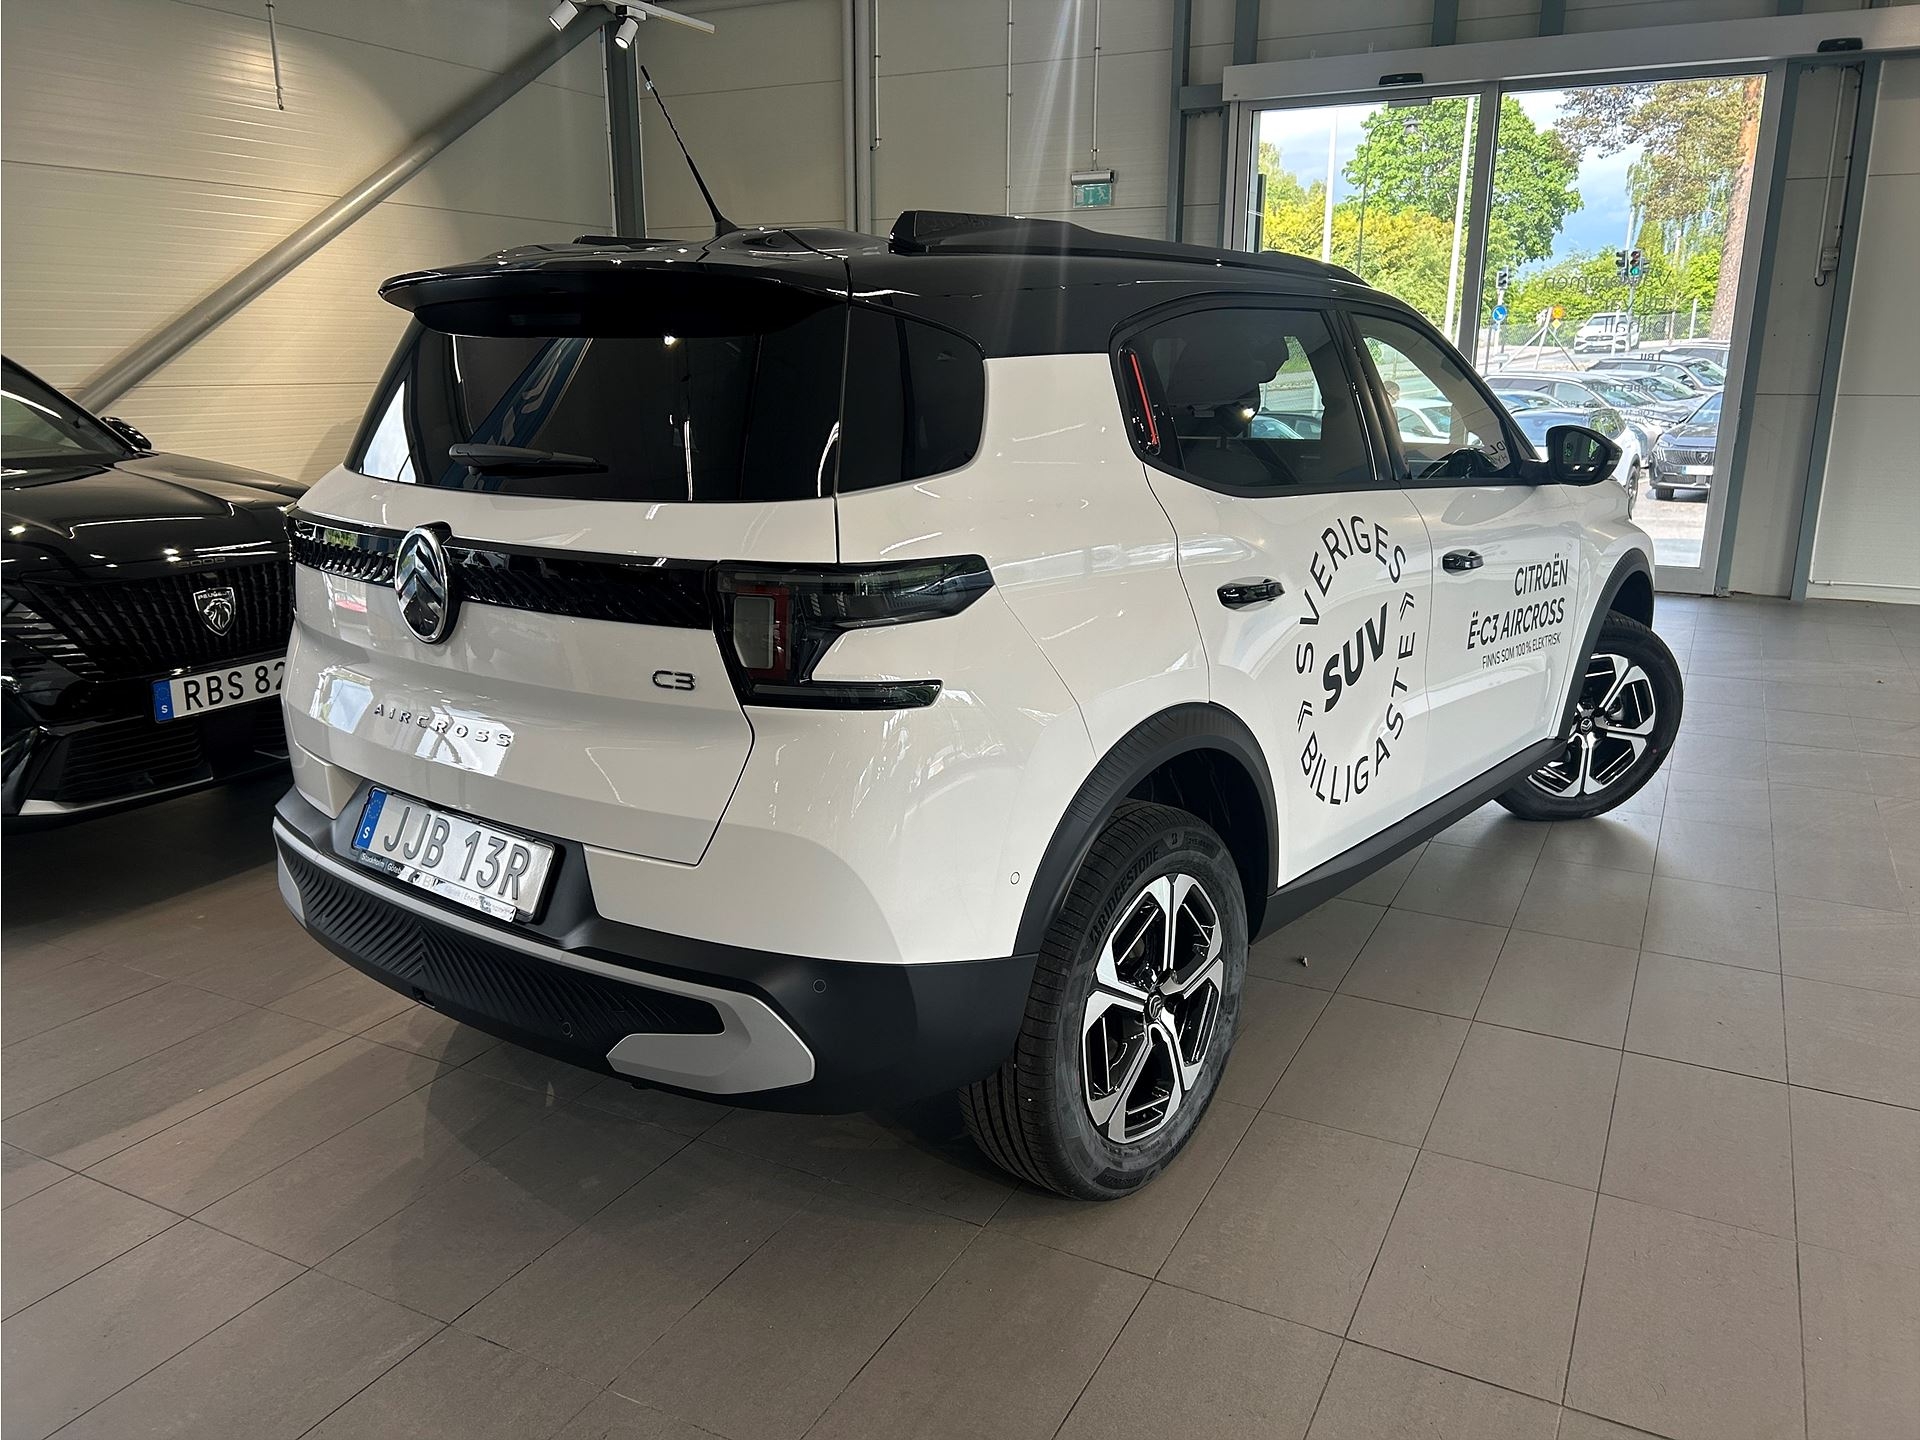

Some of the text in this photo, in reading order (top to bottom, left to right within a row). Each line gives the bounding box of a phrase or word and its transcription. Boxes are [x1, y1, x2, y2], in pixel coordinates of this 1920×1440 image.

[1296, 515, 1407, 674] SVERIGES
[1514, 552, 1569, 596] CITROËN
[1466, 597, 1565, 650] Ë-C3 AIRCROSS
[1322, 601, 1389, 713] SUV
[1482, 650, 1501, 669] FINNS
[1501, 645, 1515, 662] SOM
[1532, 631, 1562, 652] ELEKTRISK
[183, 671, 244, 711] RBS
[652, 669, 696, 691] C3
[161, 704, 168, 714] S
[374, 703, 512, 748] AIRCROSS
[1300, 631, 1416, 806] BILLIGASTE
[362, 826, 371, 840] S
[384, 806, 532, 901] JJB 13R
